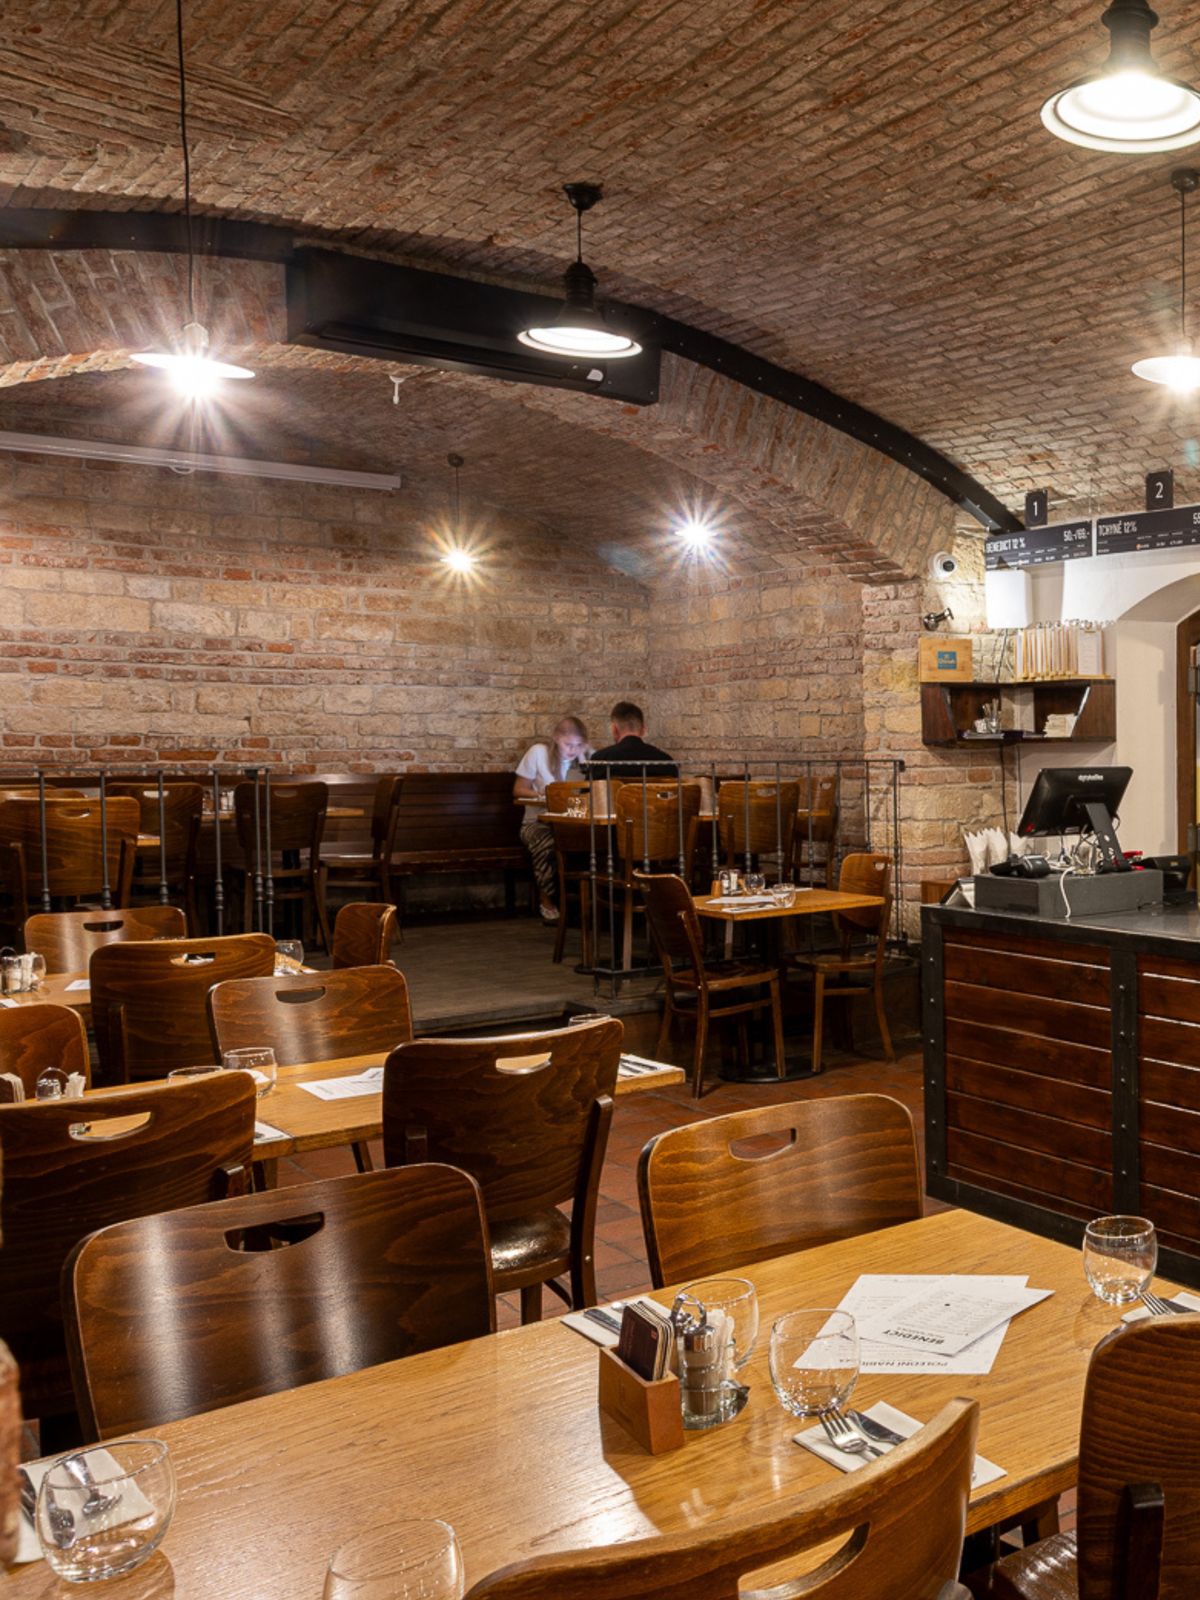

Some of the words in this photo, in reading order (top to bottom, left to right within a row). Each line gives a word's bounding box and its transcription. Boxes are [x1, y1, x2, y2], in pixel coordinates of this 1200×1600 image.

[1155, 481, 1164, 499] 2
[1033, 501, 1038, 516] 1
[882, 1329, 945, 1345] BENEDICT
